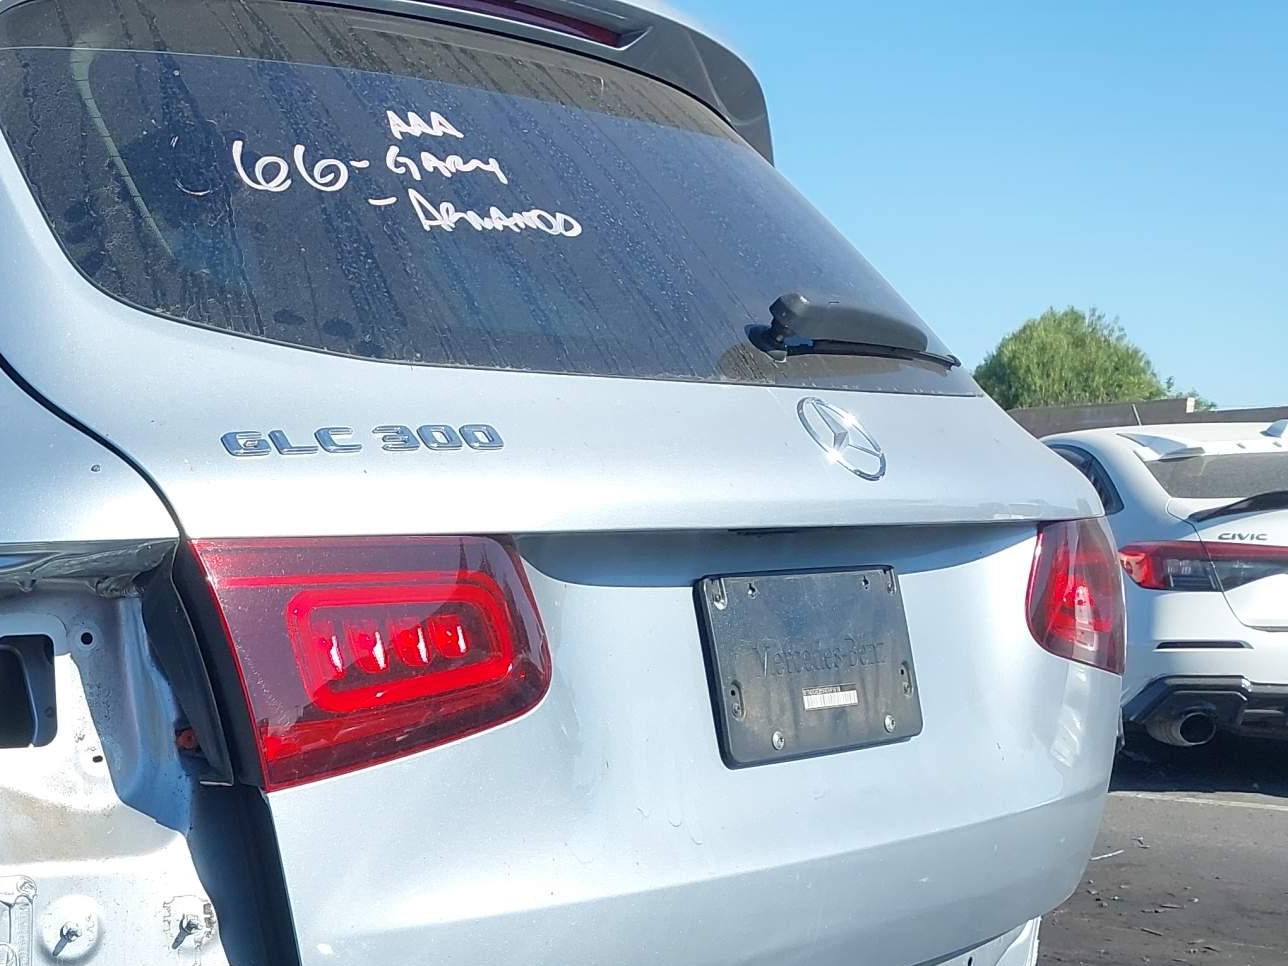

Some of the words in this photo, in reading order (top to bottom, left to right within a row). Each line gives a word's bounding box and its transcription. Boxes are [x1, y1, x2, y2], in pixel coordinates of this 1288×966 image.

[220, 426, 362, 457] GLC
[372, 424, 505, 451] 300
[1218, 532, 1269, 541] CIVIC
